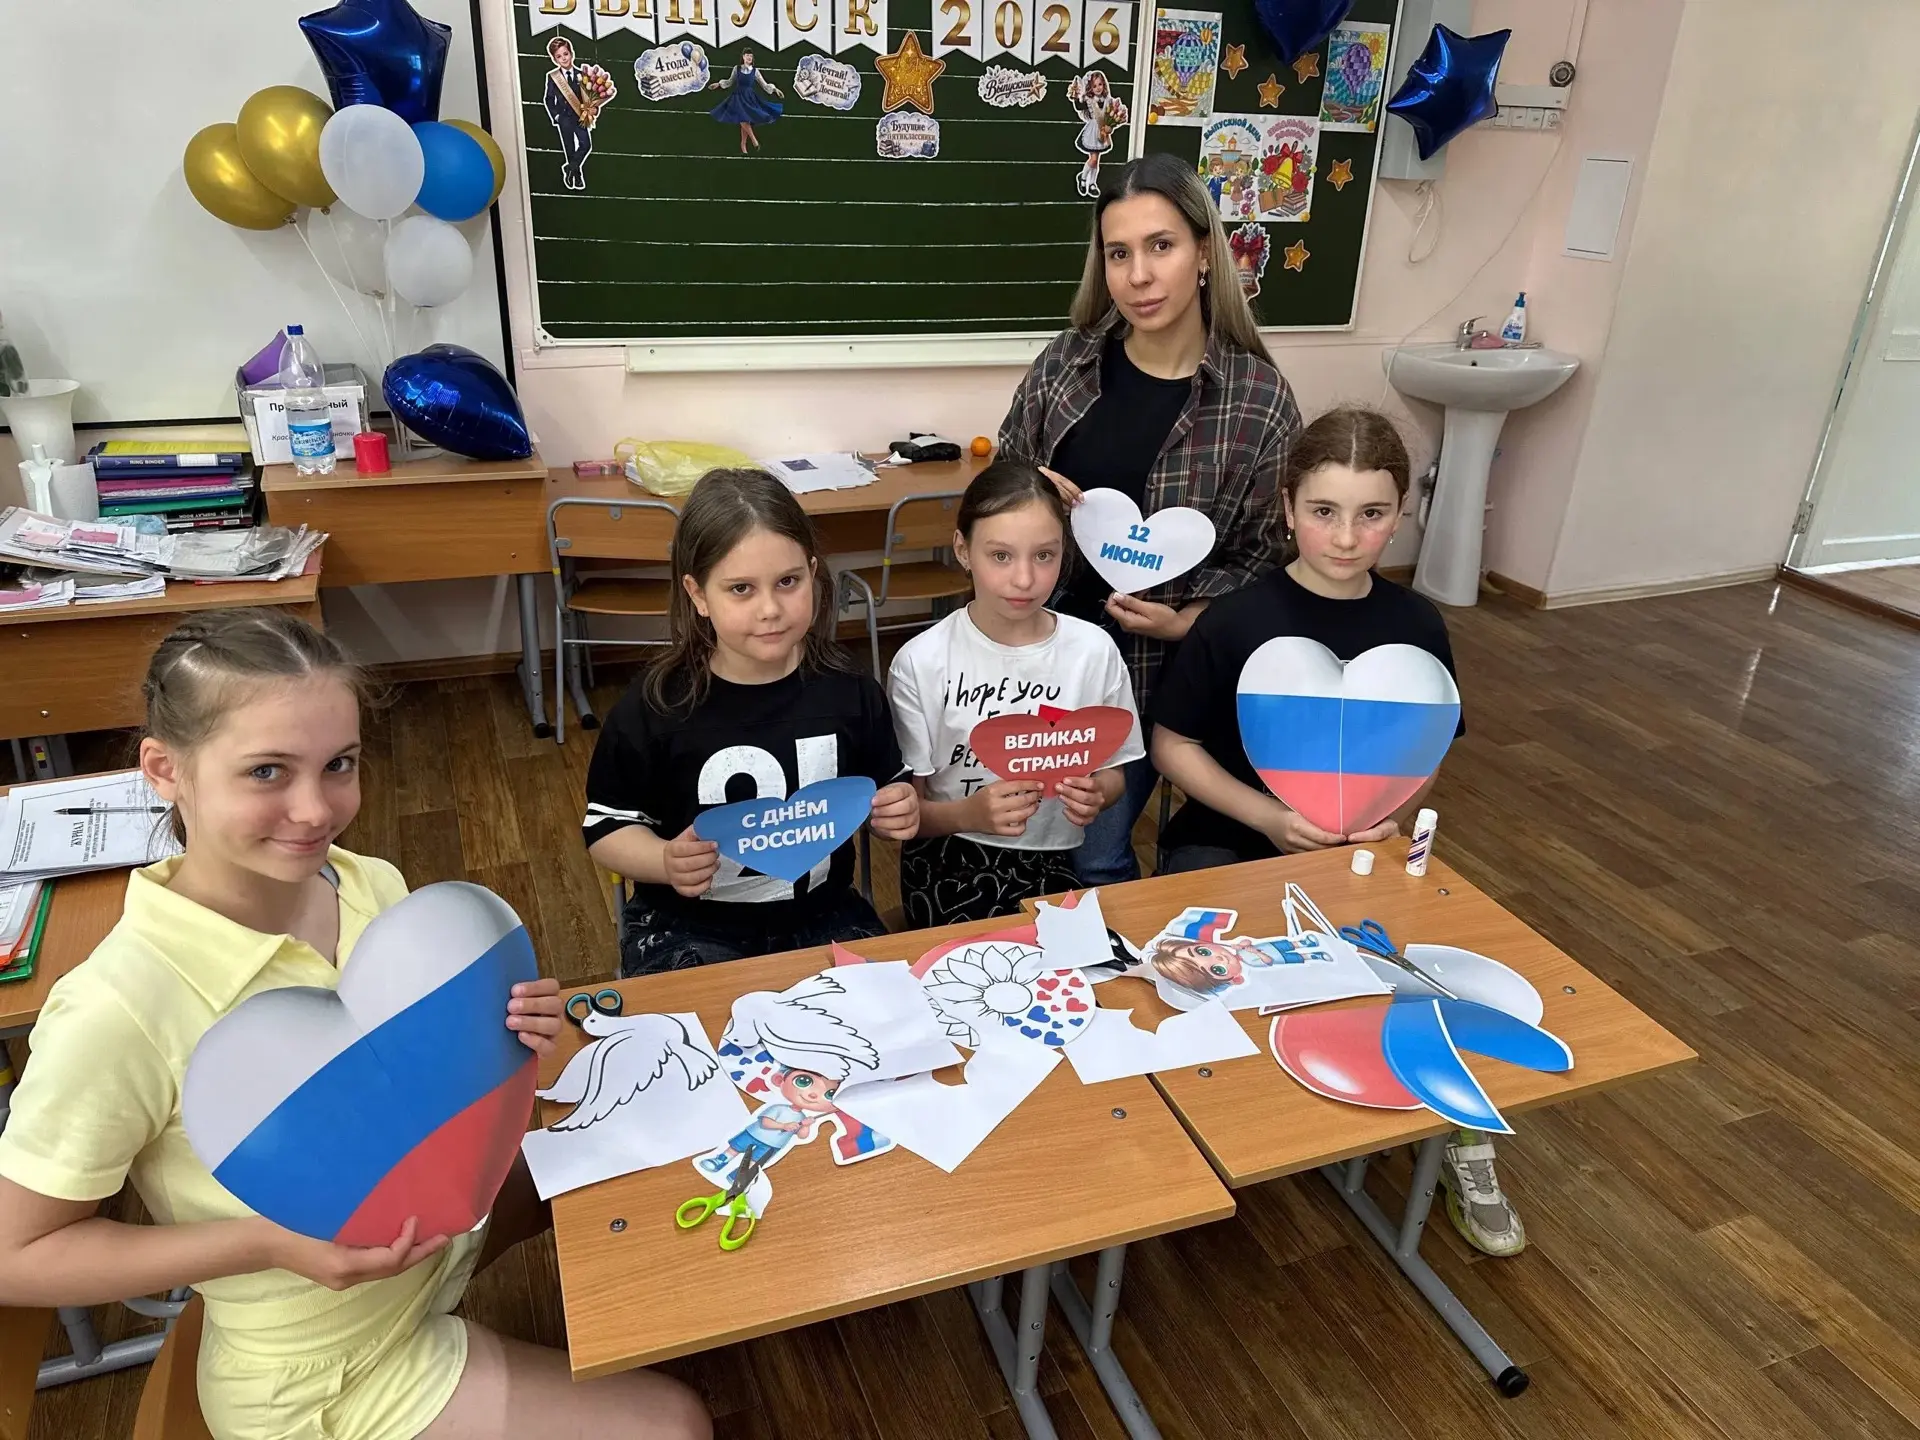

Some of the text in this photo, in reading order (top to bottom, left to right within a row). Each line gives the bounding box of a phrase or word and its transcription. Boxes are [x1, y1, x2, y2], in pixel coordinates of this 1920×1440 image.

[940, 0, 1121, 55] 2026
[655, 57, 690, 73] 4 года
[661, 67, 695, 84] вместе!
[813, 61, 849, 80] Мечтай!
[820, 74, 845, 90] Учись!
[891, 120, 926, 132] Будущие
[1203, 118, 1248, 140] ВЫПУСКНОЙ
[1127, 524, 1151, 543] 12
[1100, 543, 1164, 571] ИЮНЯ!
[1010, 680, 1061, 704] you
[1004, 727, 1096, 750] ВЕЛИКАЯ
[1007, 750, 1090, 774] СТРАНА!
[741, 799, 828, 829] С ДНЁМ
[737, 821, 836, 855] РОССИИ!
